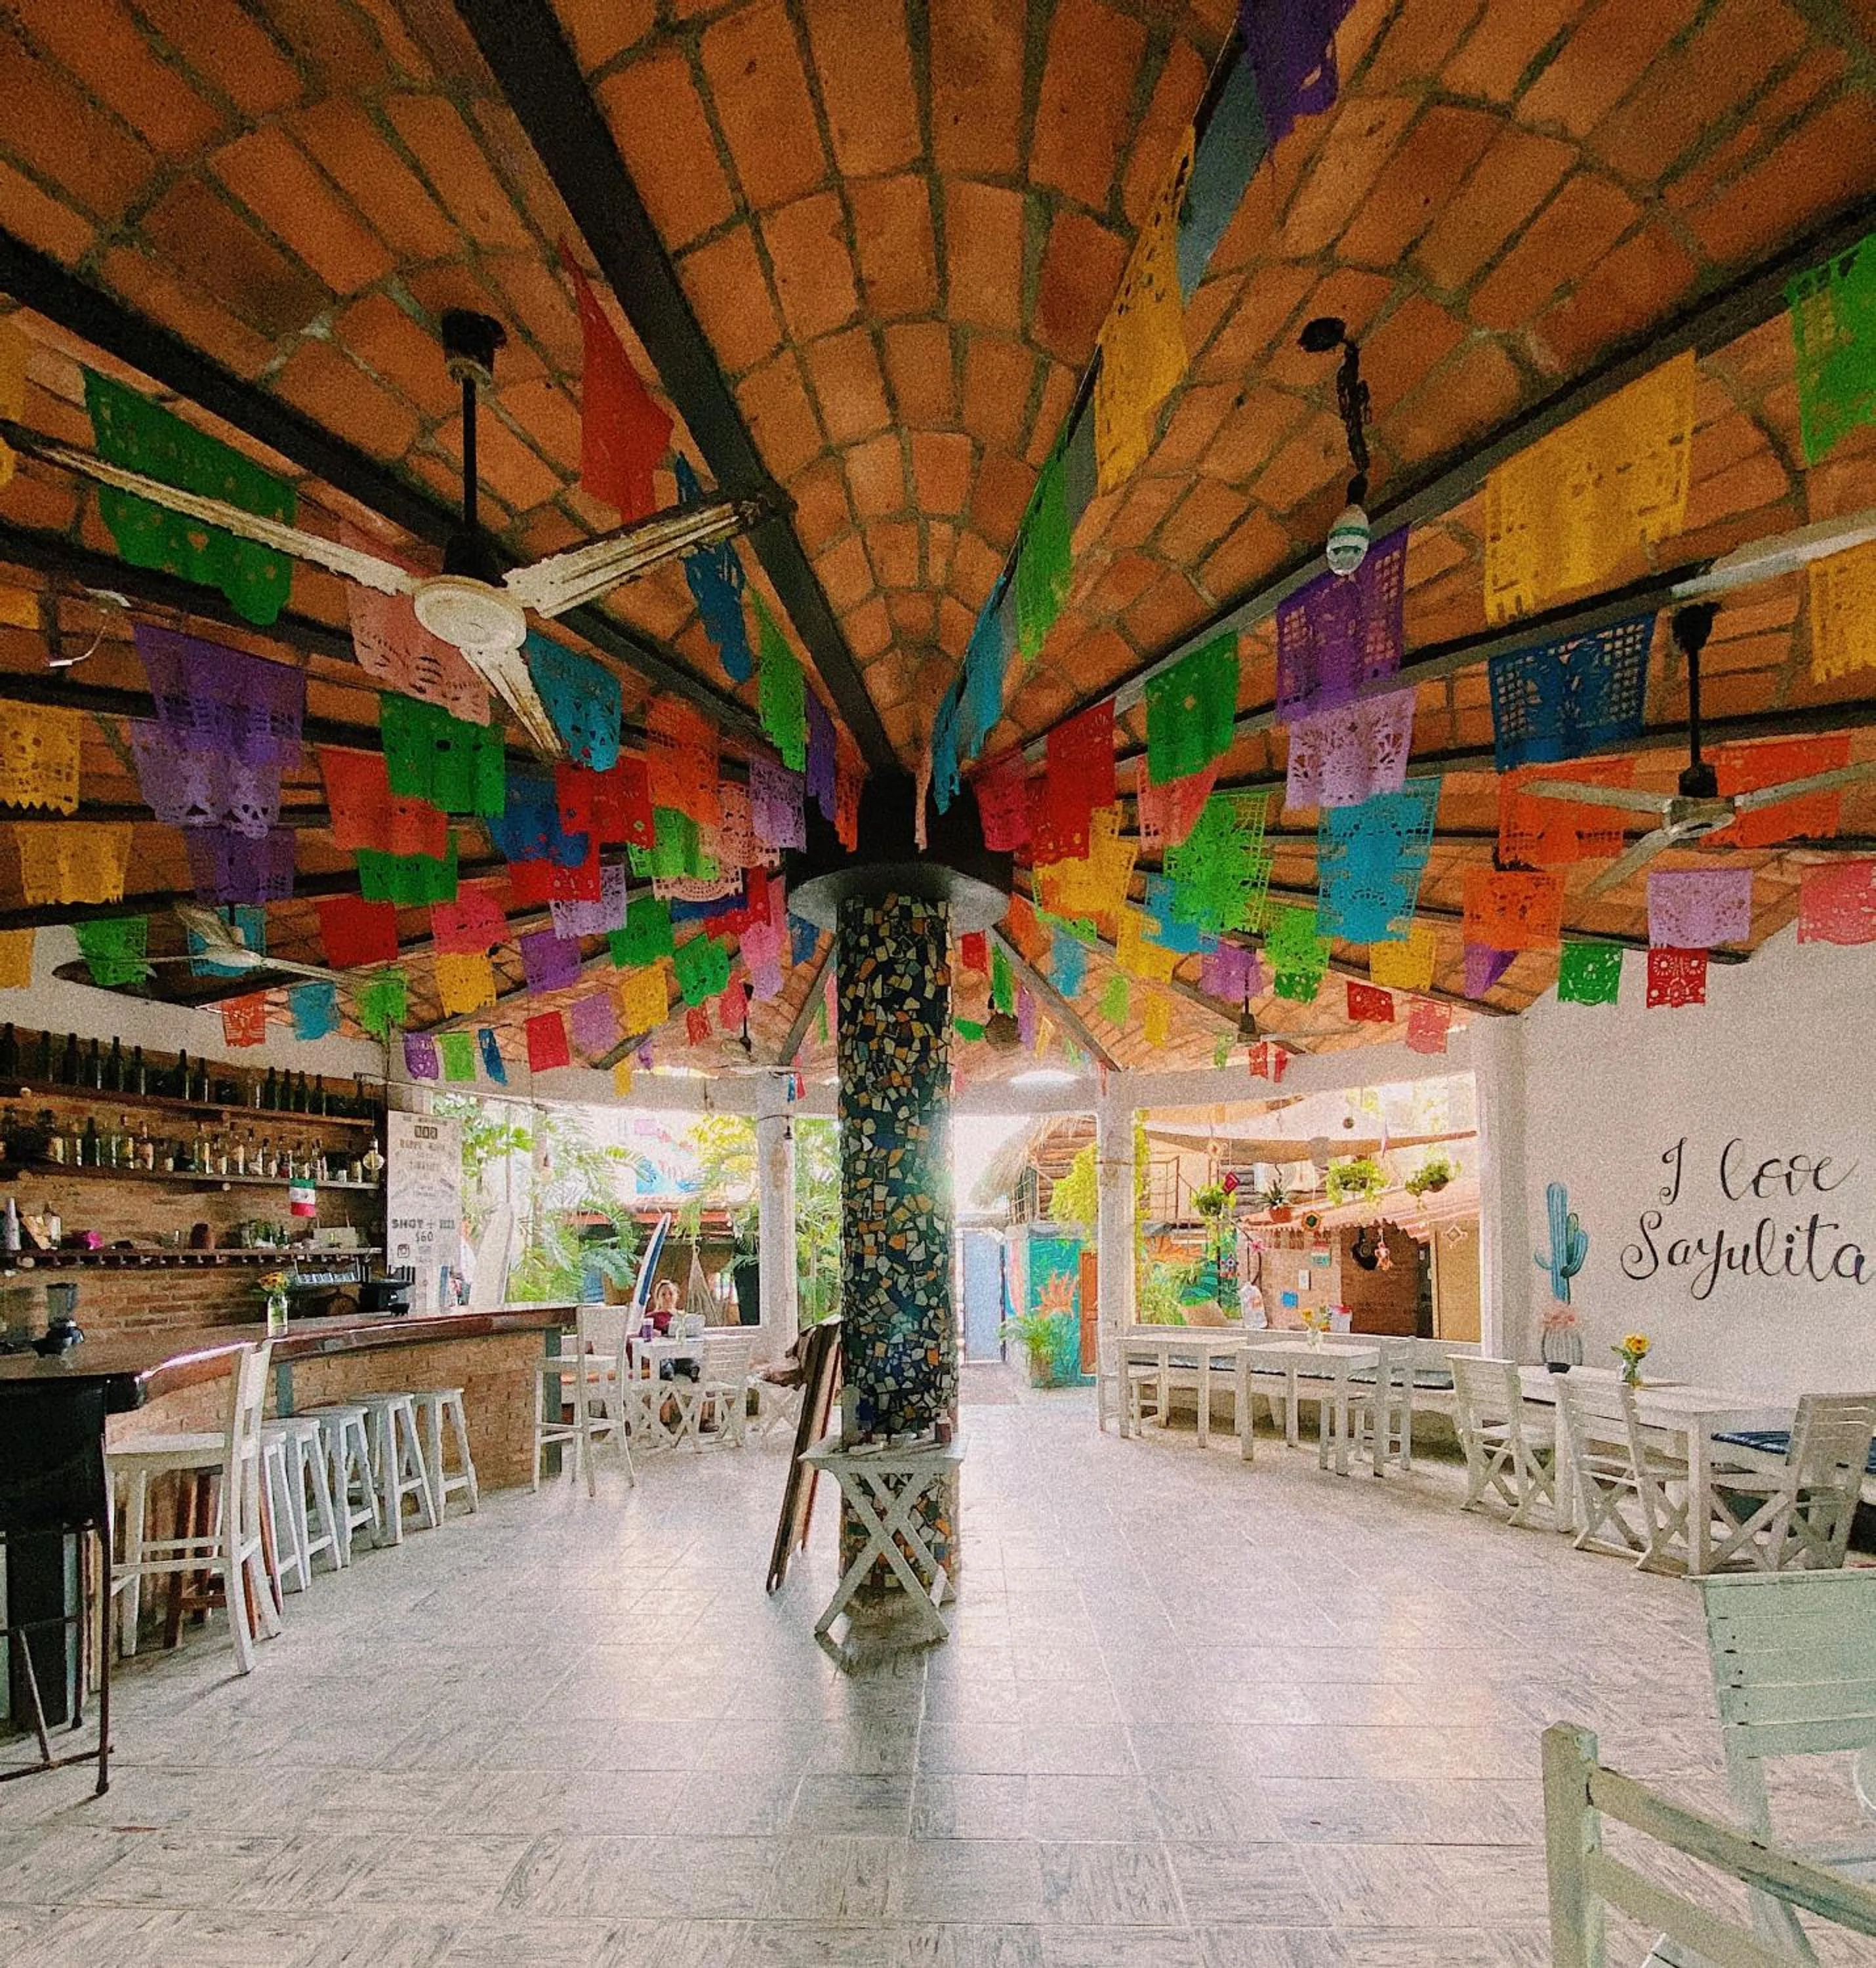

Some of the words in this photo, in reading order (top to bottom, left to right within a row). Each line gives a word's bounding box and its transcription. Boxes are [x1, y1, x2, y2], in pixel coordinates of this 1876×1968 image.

[1659, 1136, 1688, 1206] I
[1720, 1138, 1858, 1201] love
[392, 1218, 424, 1229] SHOT
[1620, 1210, 1876, 1300] Sayulita
